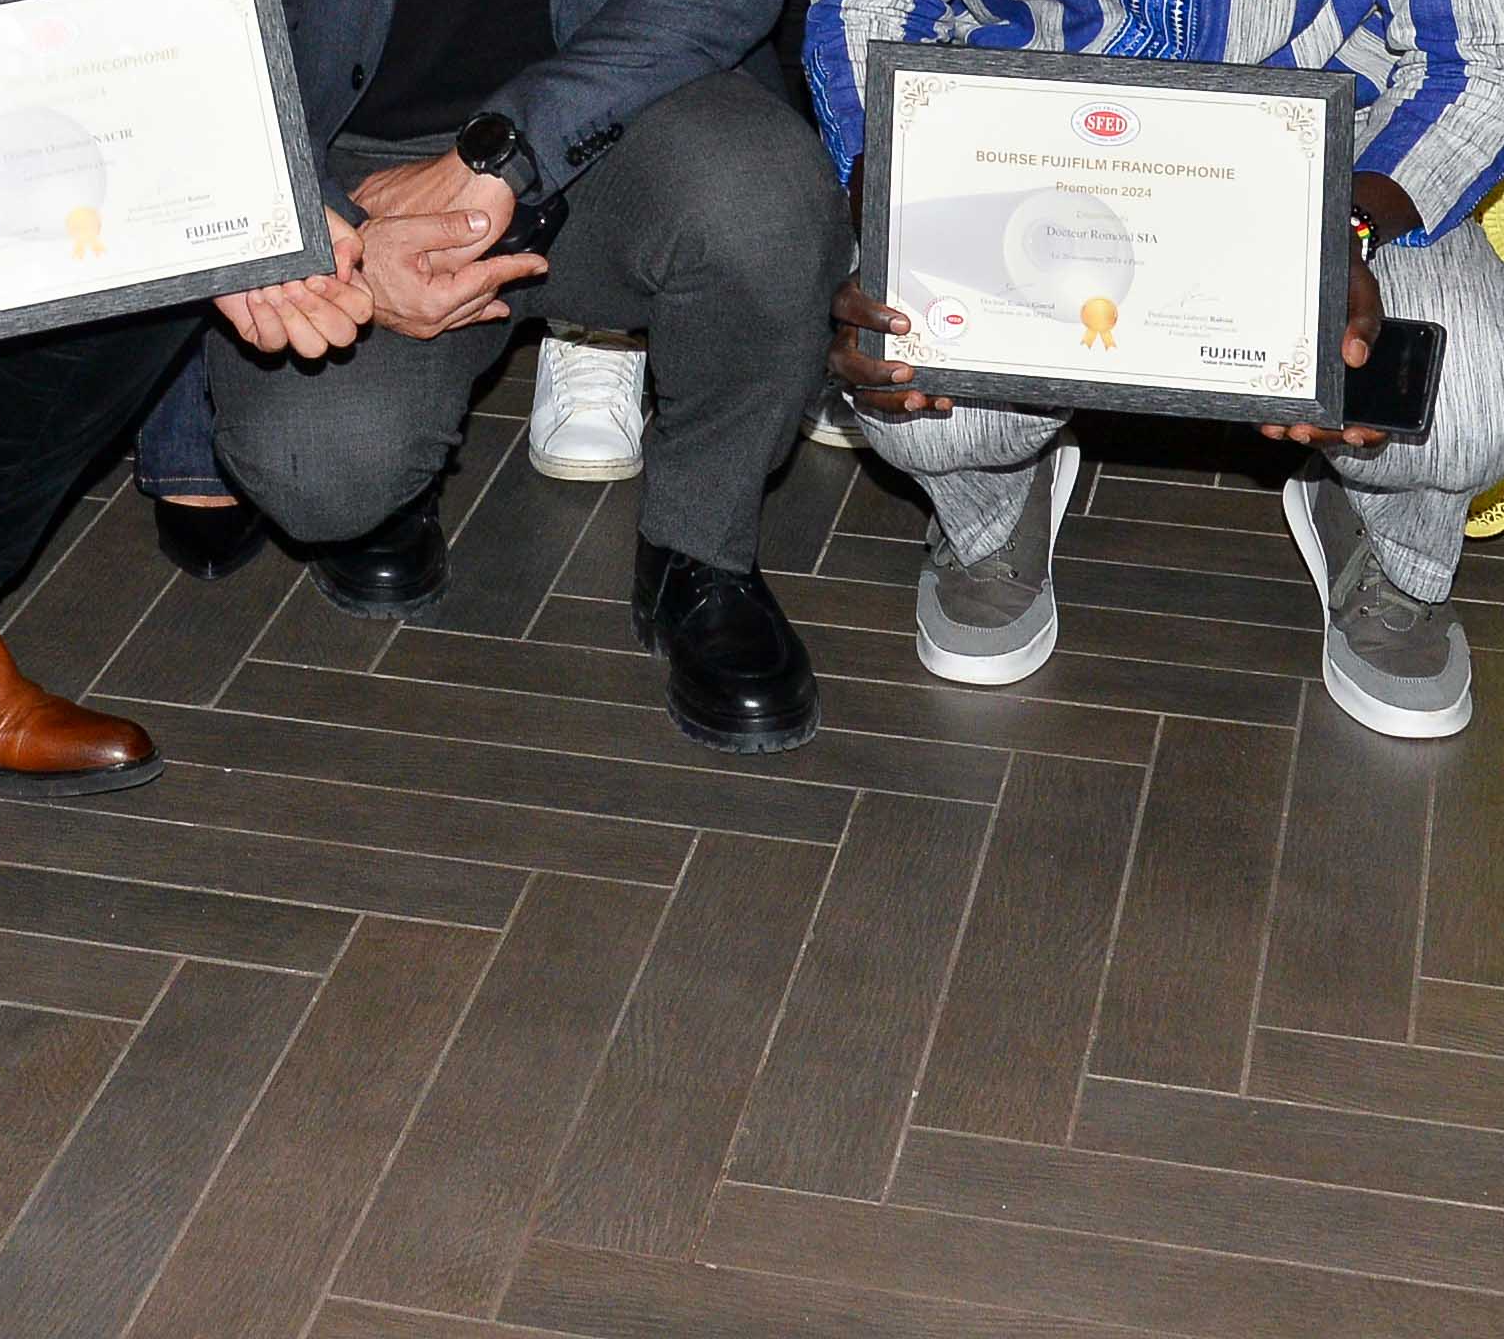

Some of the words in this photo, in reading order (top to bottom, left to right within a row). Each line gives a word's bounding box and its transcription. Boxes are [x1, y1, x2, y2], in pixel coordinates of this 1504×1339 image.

[1086, 115, 1126, 132] SFED
[976, 150, 1037, 166] BOURSE
[1041, 155, 1108, 171] FUJIFILM
[1112, 159, 1236, 180] FRANCOPHONIE
[1056, 181, 1118, 198] Promotion
[1121, 186, 1152, 199] 2024
[185, 216, 249, 239] FUJIFILM
[1046, 226, 1088, 239] Docteur
[1136, 232, 1158, 244] SIA
[1200, 346, 1266, 362] FUJIFILM
